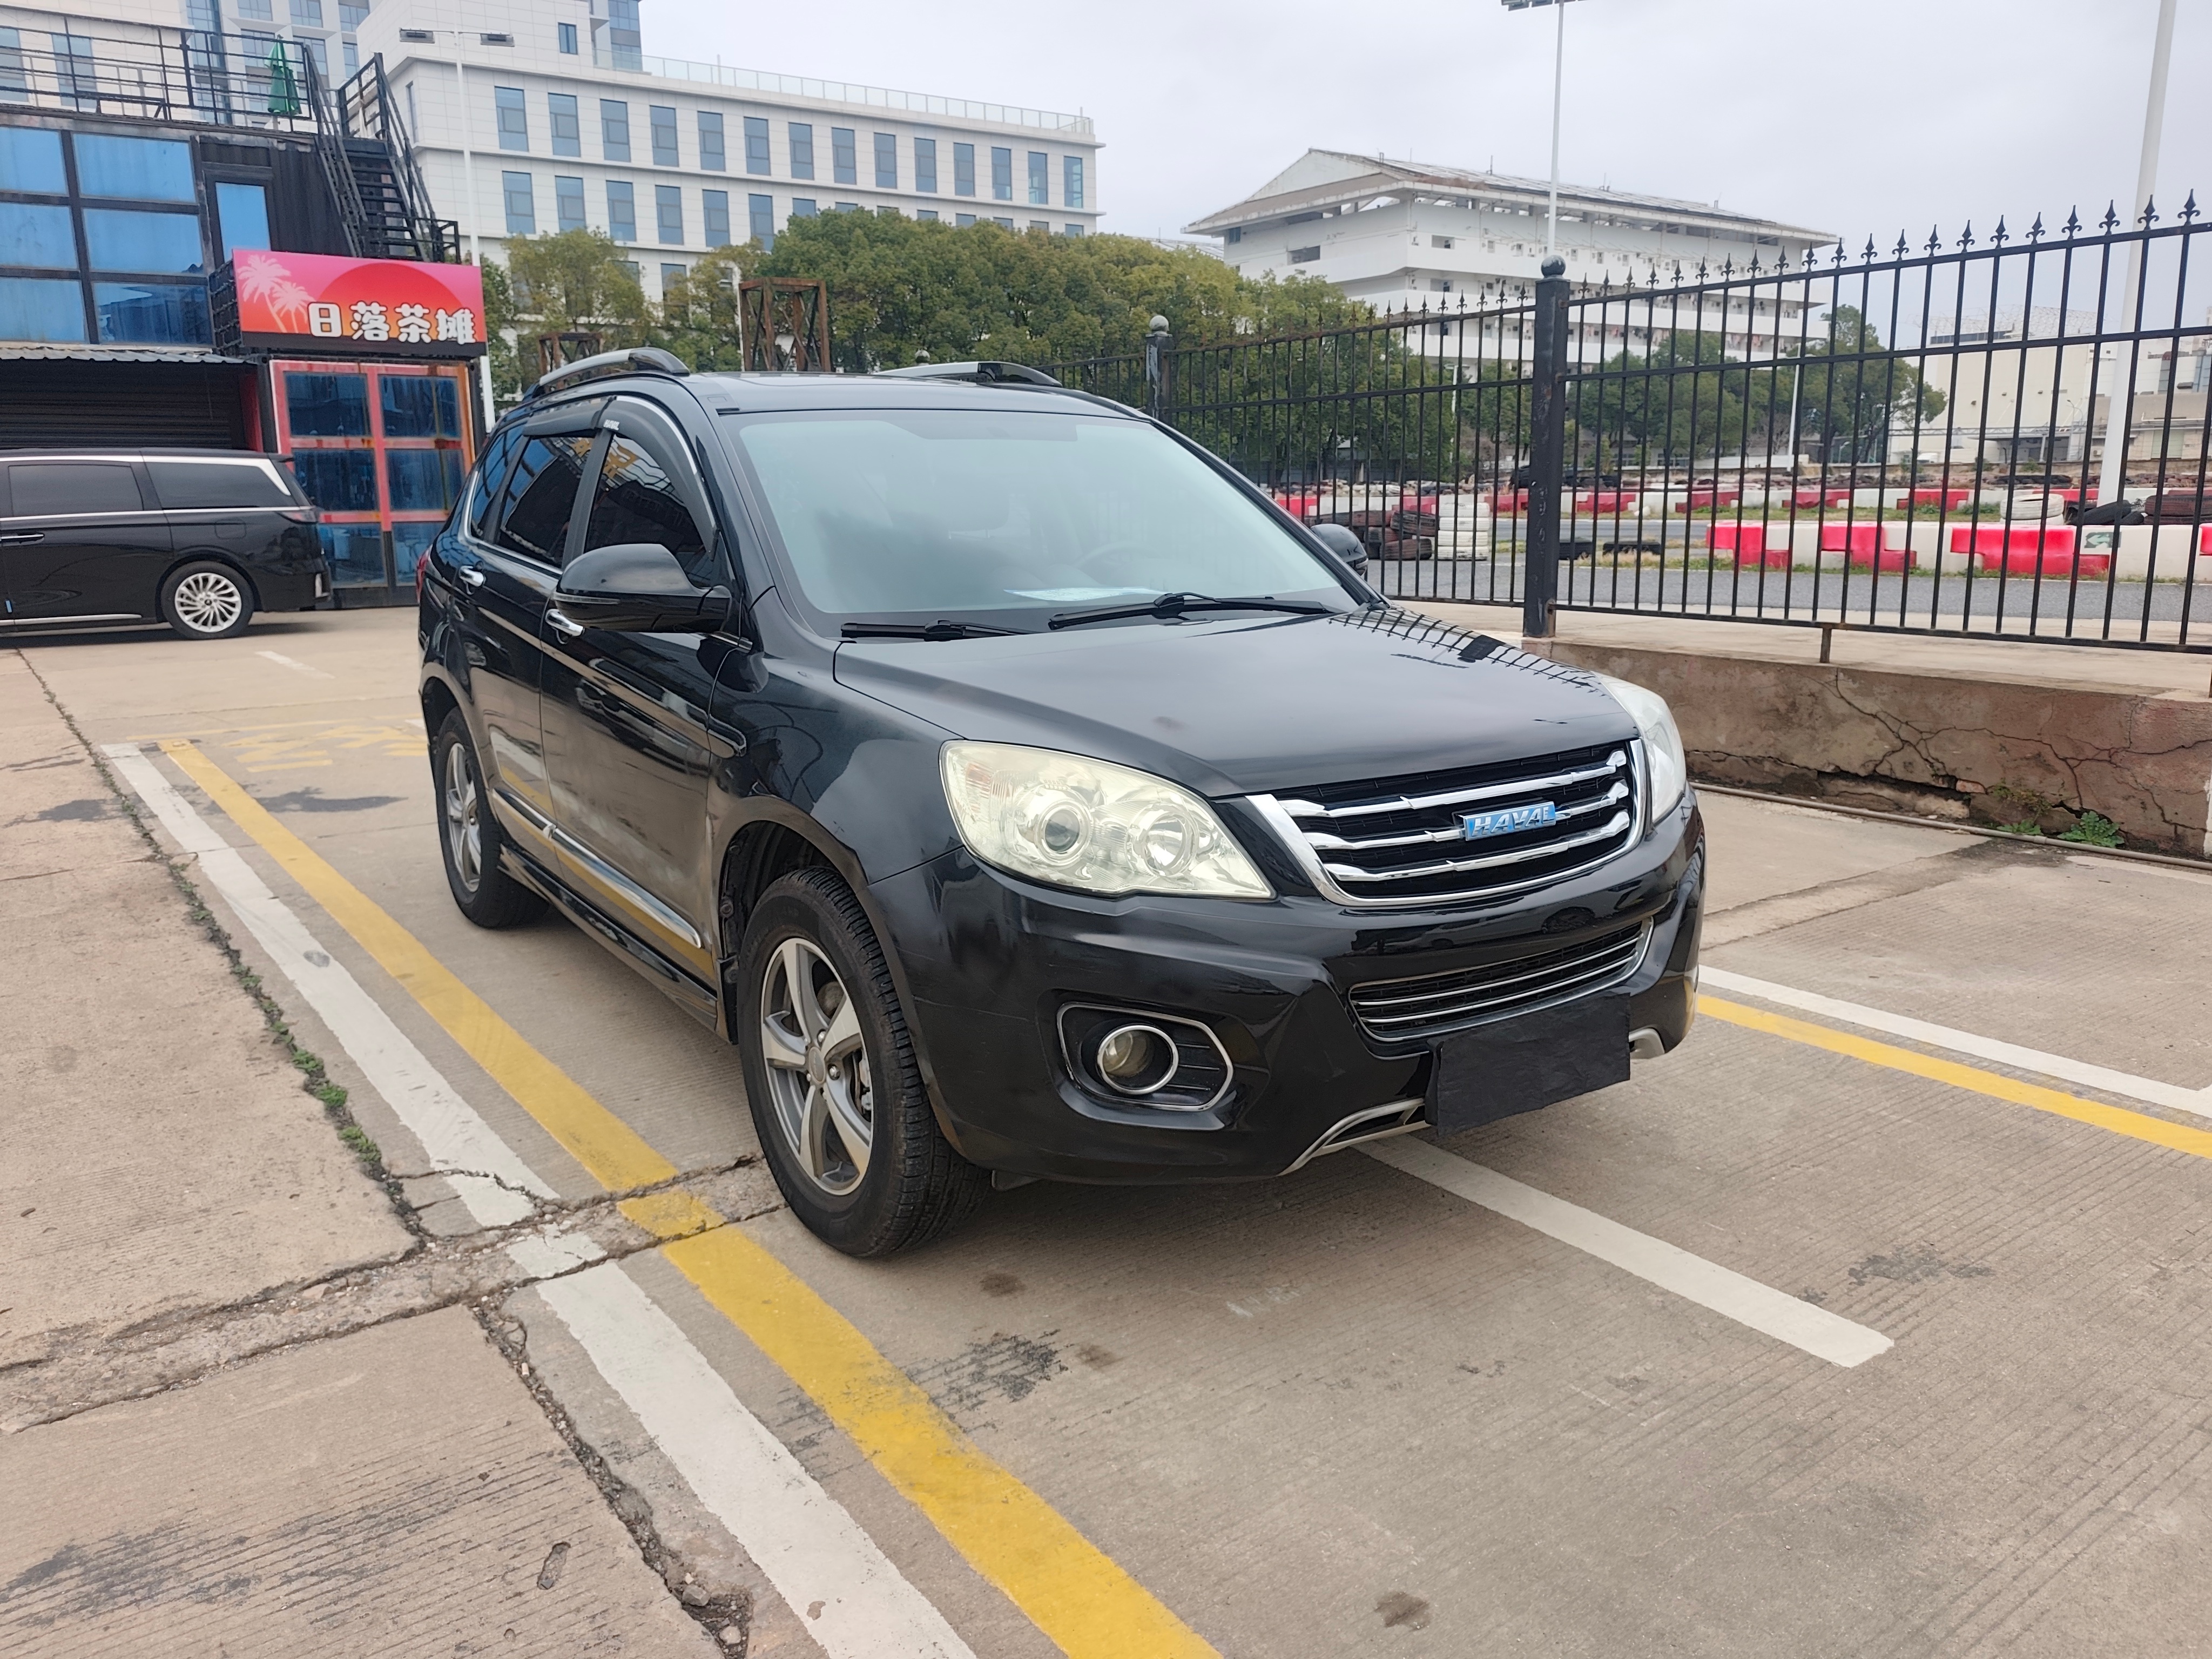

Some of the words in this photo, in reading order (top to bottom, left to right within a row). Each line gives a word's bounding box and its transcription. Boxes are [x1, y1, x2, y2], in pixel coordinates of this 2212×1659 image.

[308, 300, 476, 345] 日落茶摊
[1472, 806, 1555, 837] HAVAL
